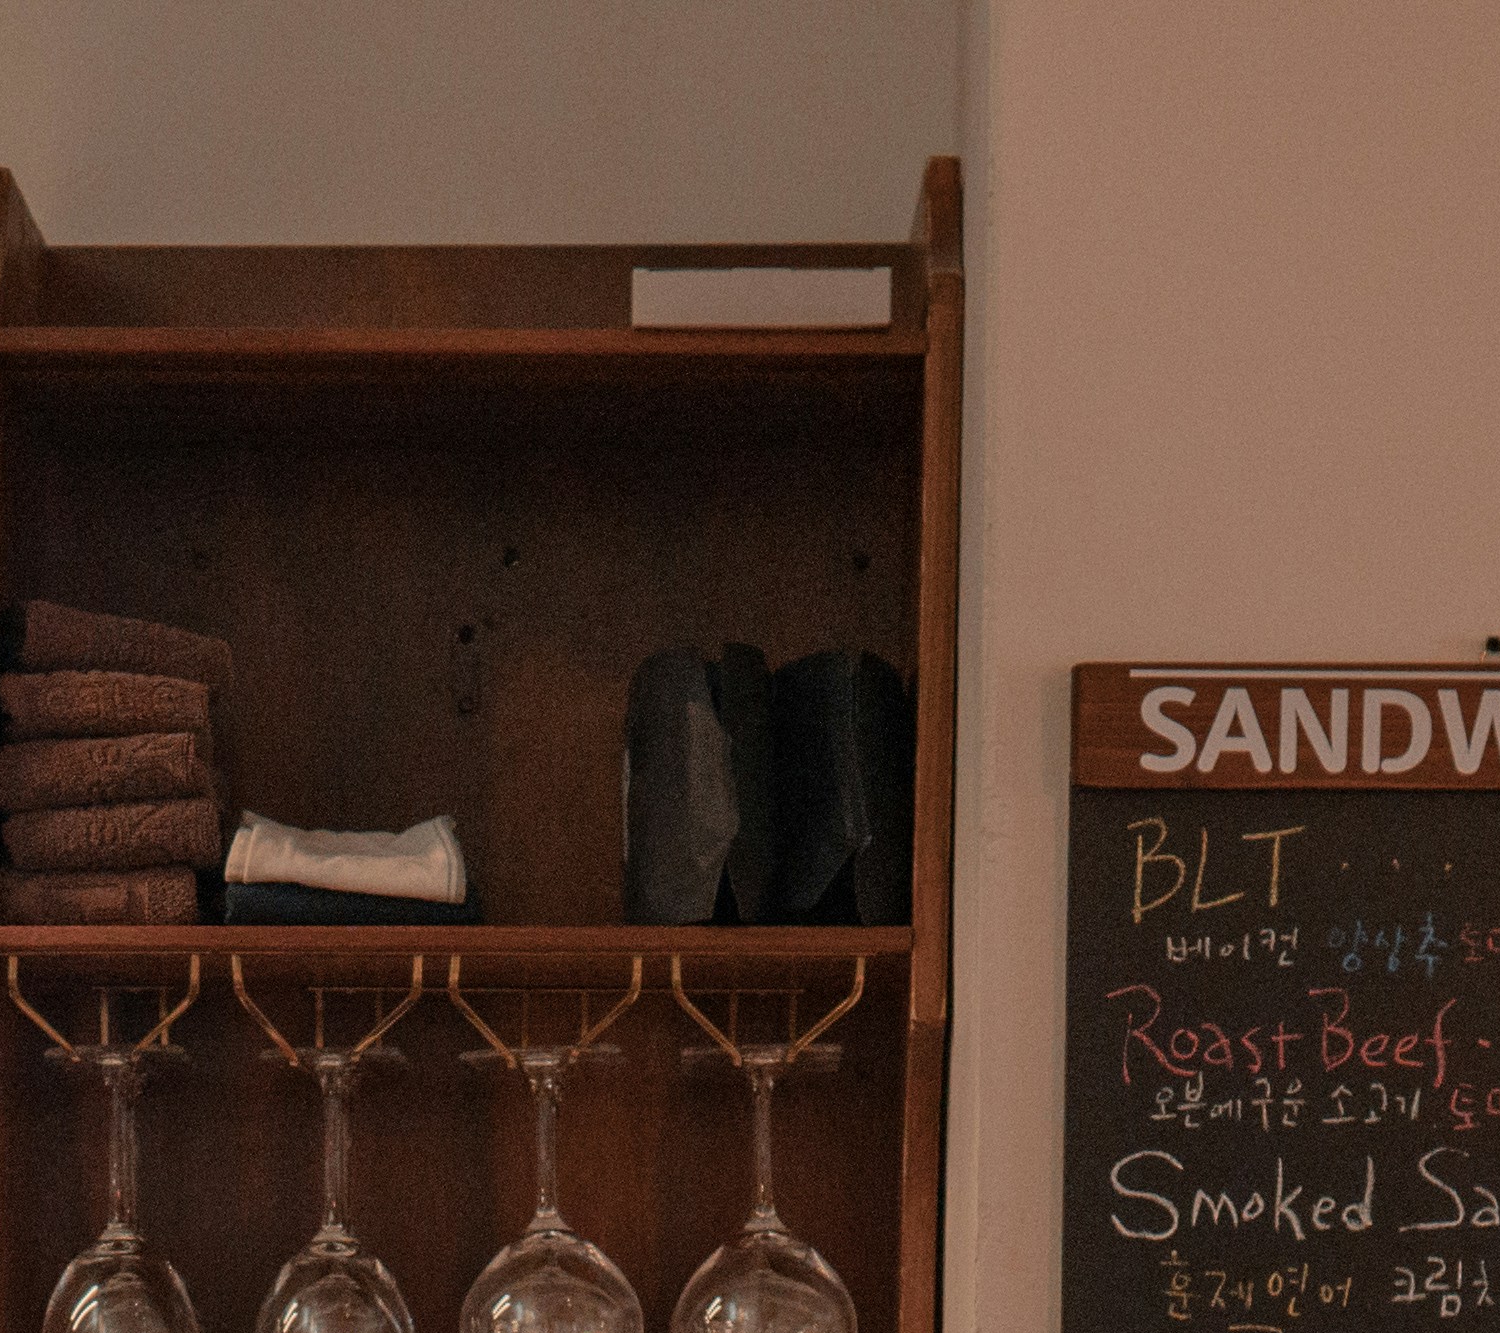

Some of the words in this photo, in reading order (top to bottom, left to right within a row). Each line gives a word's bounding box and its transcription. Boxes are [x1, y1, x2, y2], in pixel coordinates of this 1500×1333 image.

[1126, 816, 1307, 924] BLT
[1166, 928, 1299, 966] 베이컨
[1328, 912, 1448, 977] 양상추
[1106, 984, 1304, 1085] Roast
[1308, 988, 1457, 1089] Beef
[1321, 1083, 1421, 1125] 소고기
[1110, 1150, 1374, 1240] Smoked
[1160, 1250, 1352, 1320] 훈제연어
